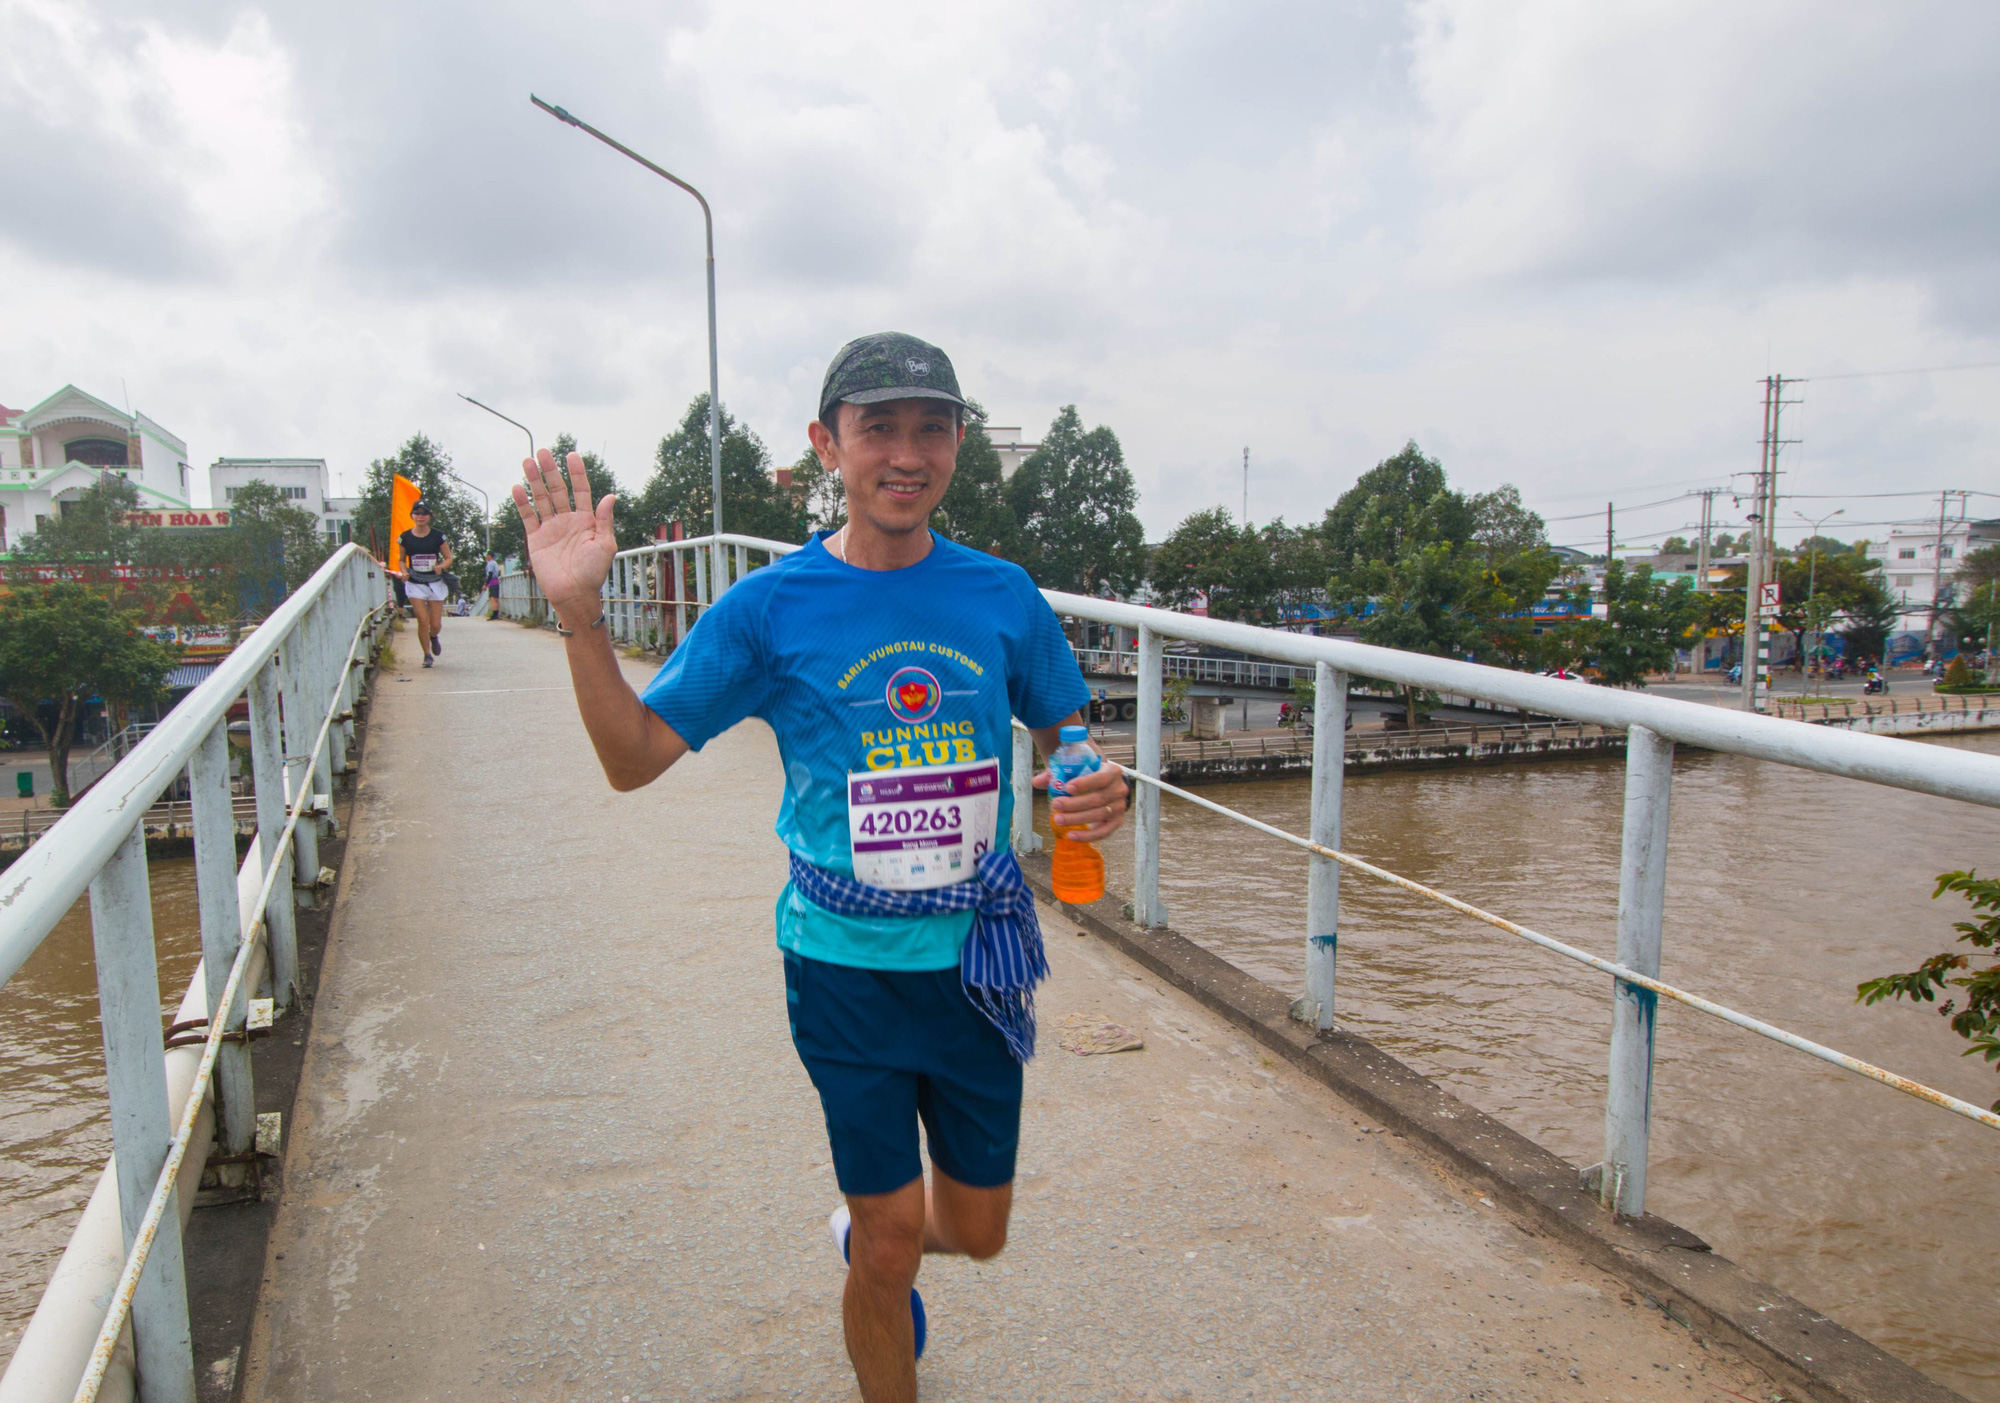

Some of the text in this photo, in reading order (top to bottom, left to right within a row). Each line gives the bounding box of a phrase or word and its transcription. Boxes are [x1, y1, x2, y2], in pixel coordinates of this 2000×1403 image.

[909, 360, 928, 373] Buff
[169, 510, 213, 526] HÒA
[837, 641, 984, 690] BARIA-VUNGTAU CUSTOMS
[861, 720, 975, 747] RUNNING
[866, 738, 977, 770] CLUB
[859, 805, 962, 836] 420263
